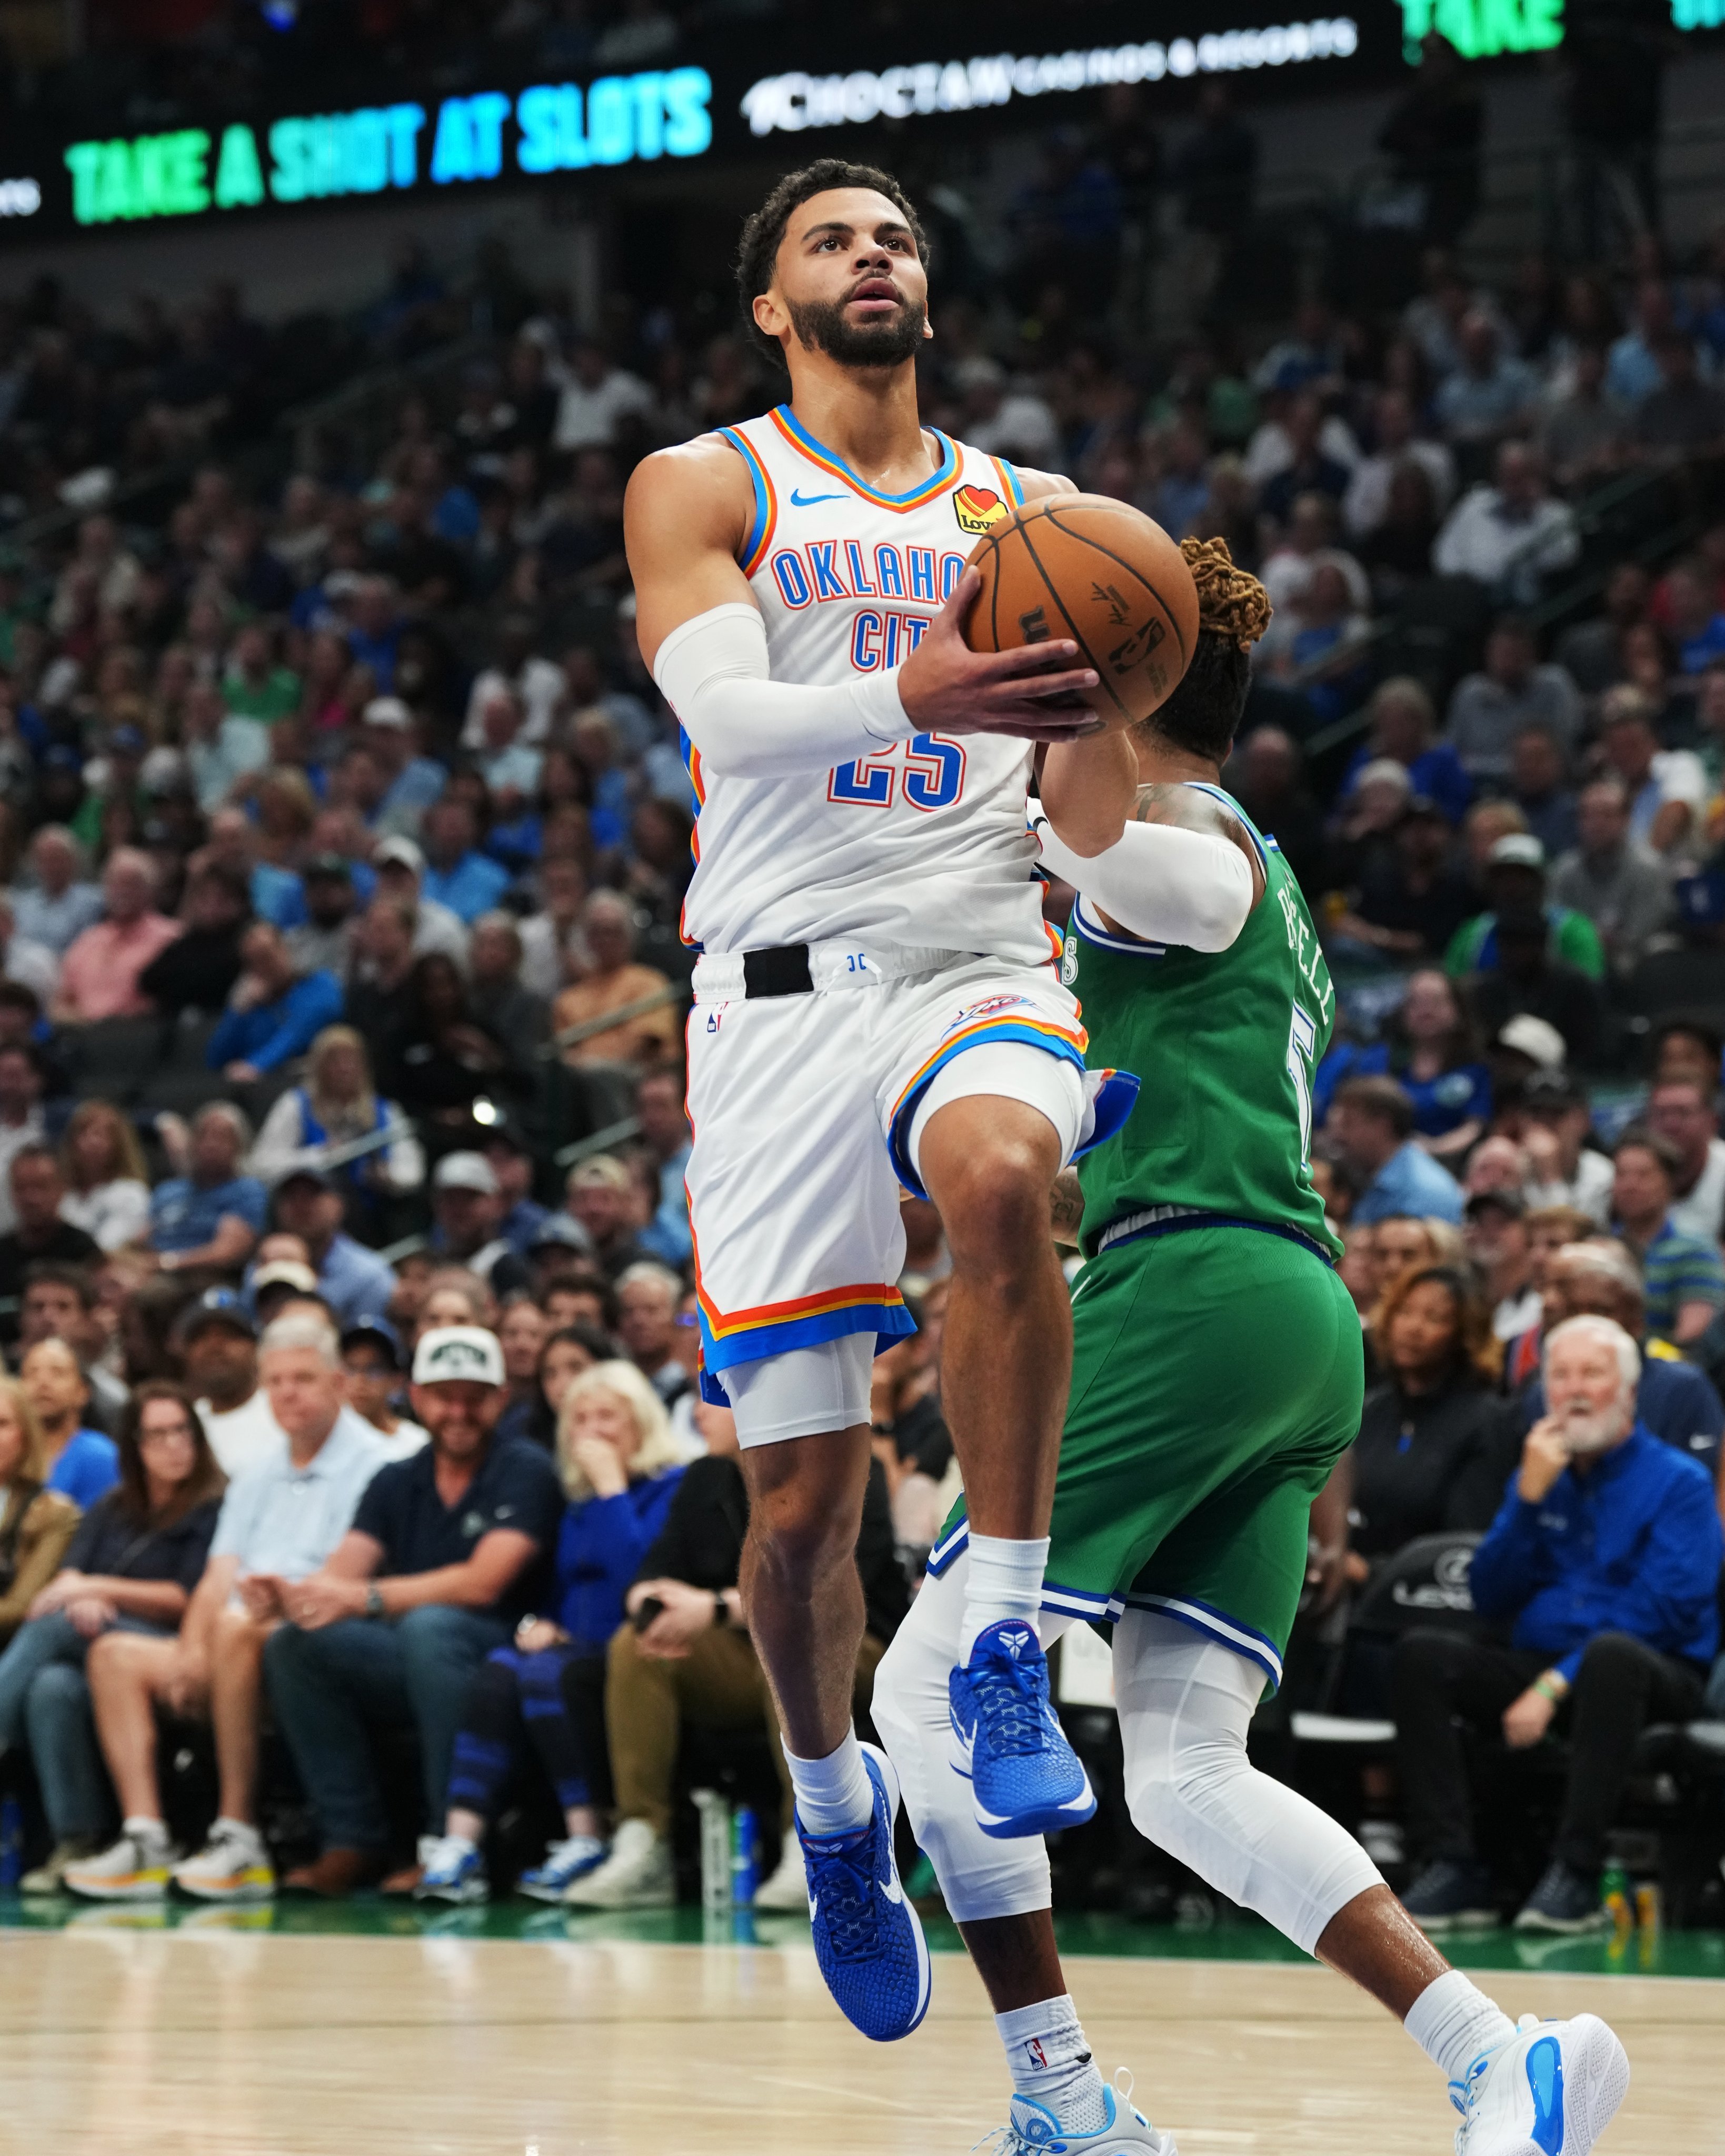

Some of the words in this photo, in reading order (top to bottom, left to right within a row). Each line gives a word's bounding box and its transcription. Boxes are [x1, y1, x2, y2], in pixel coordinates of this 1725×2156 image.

[65, 129, 211, 224] TAKE
[215, 124, 264, 207] A
[269, 103, 425, 201] SHOT
[430, 91, 511, 184] AT
[516, 66, 712, 173] SLOTS
[961, 514, 995, 531] Lov
[771, 540, 967, 611] OKLAHO
[850, 608, 934, 673] CIT
